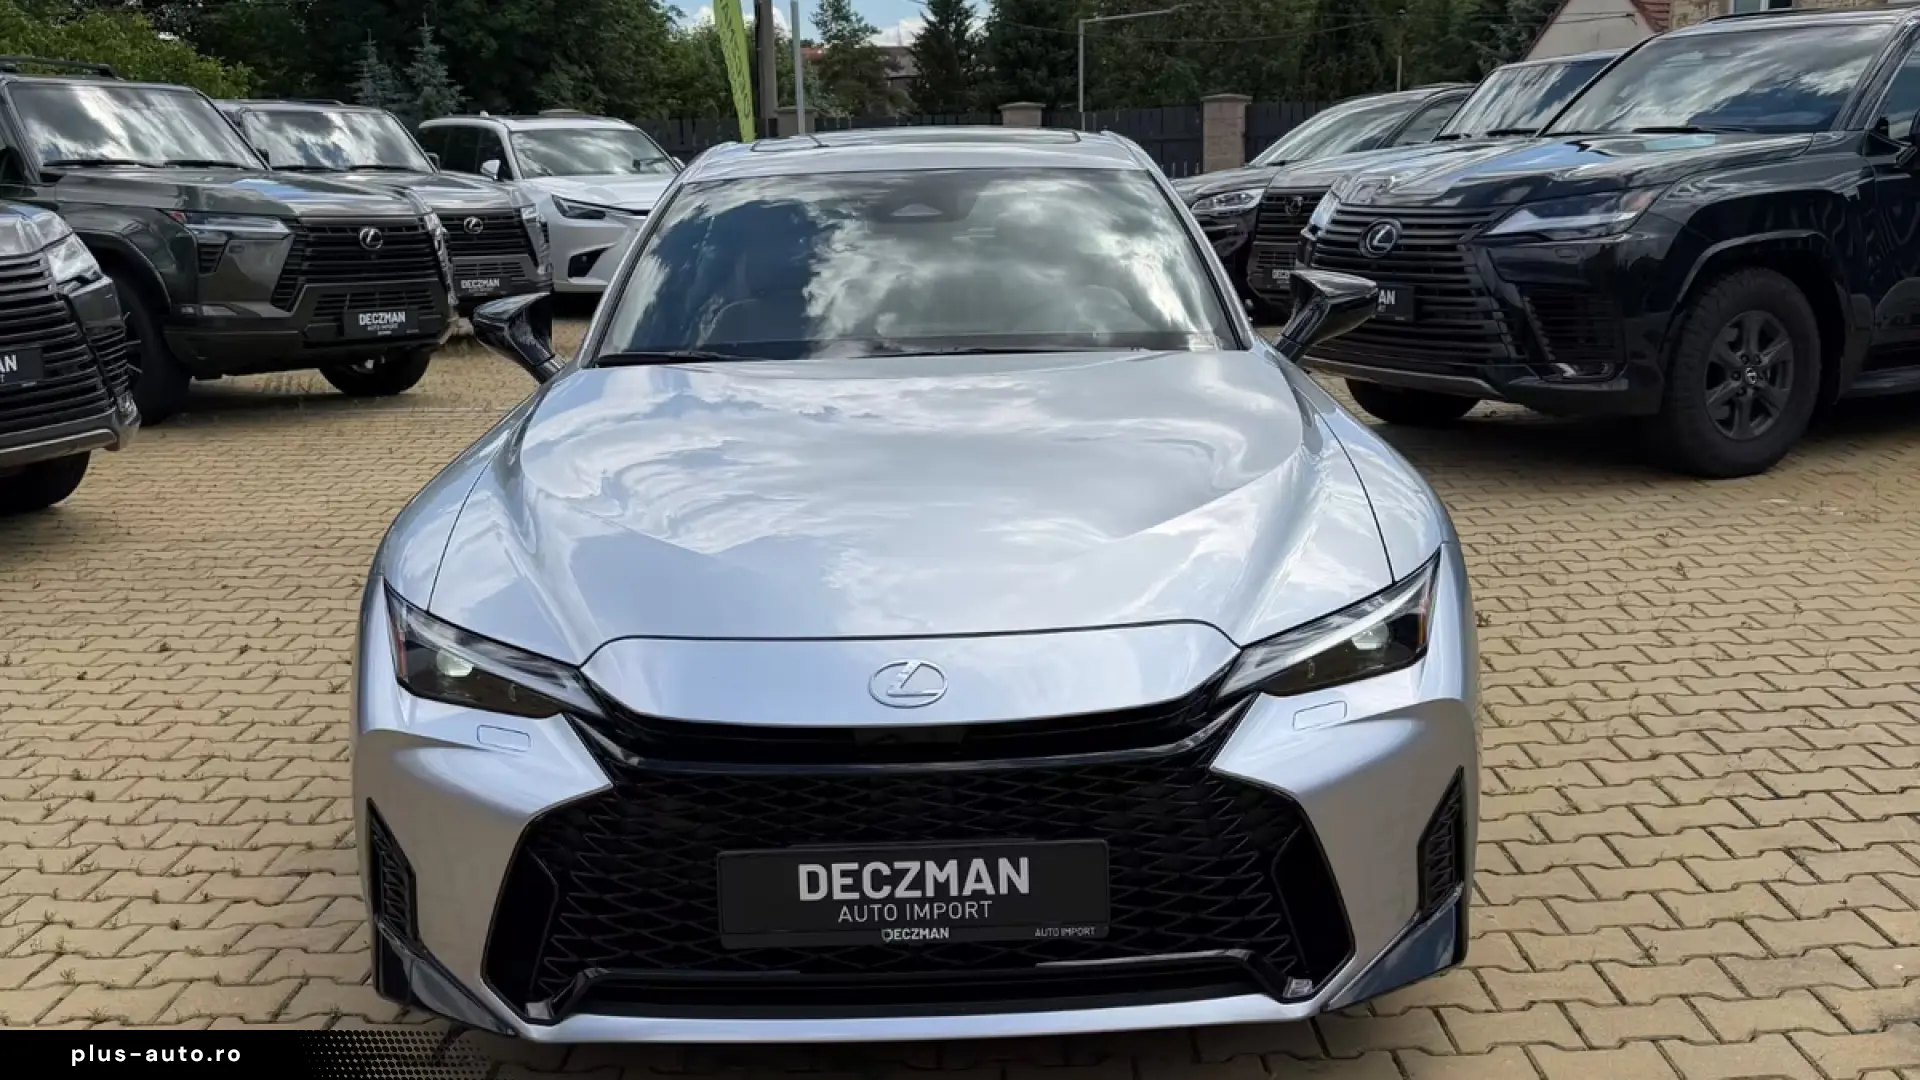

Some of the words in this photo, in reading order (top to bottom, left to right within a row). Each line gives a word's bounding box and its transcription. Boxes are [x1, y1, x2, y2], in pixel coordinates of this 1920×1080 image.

[359, 312, 406, 325] DECZMAN
[798, 857, 1030, 901] DECZMAN
[838, 904, 898, 923] AUTO
[906, 901, 992, 920] IMPORT
[1035, 928, 1059, 937] AUTO
[1061, 927, 1095, 936] IMPORT
